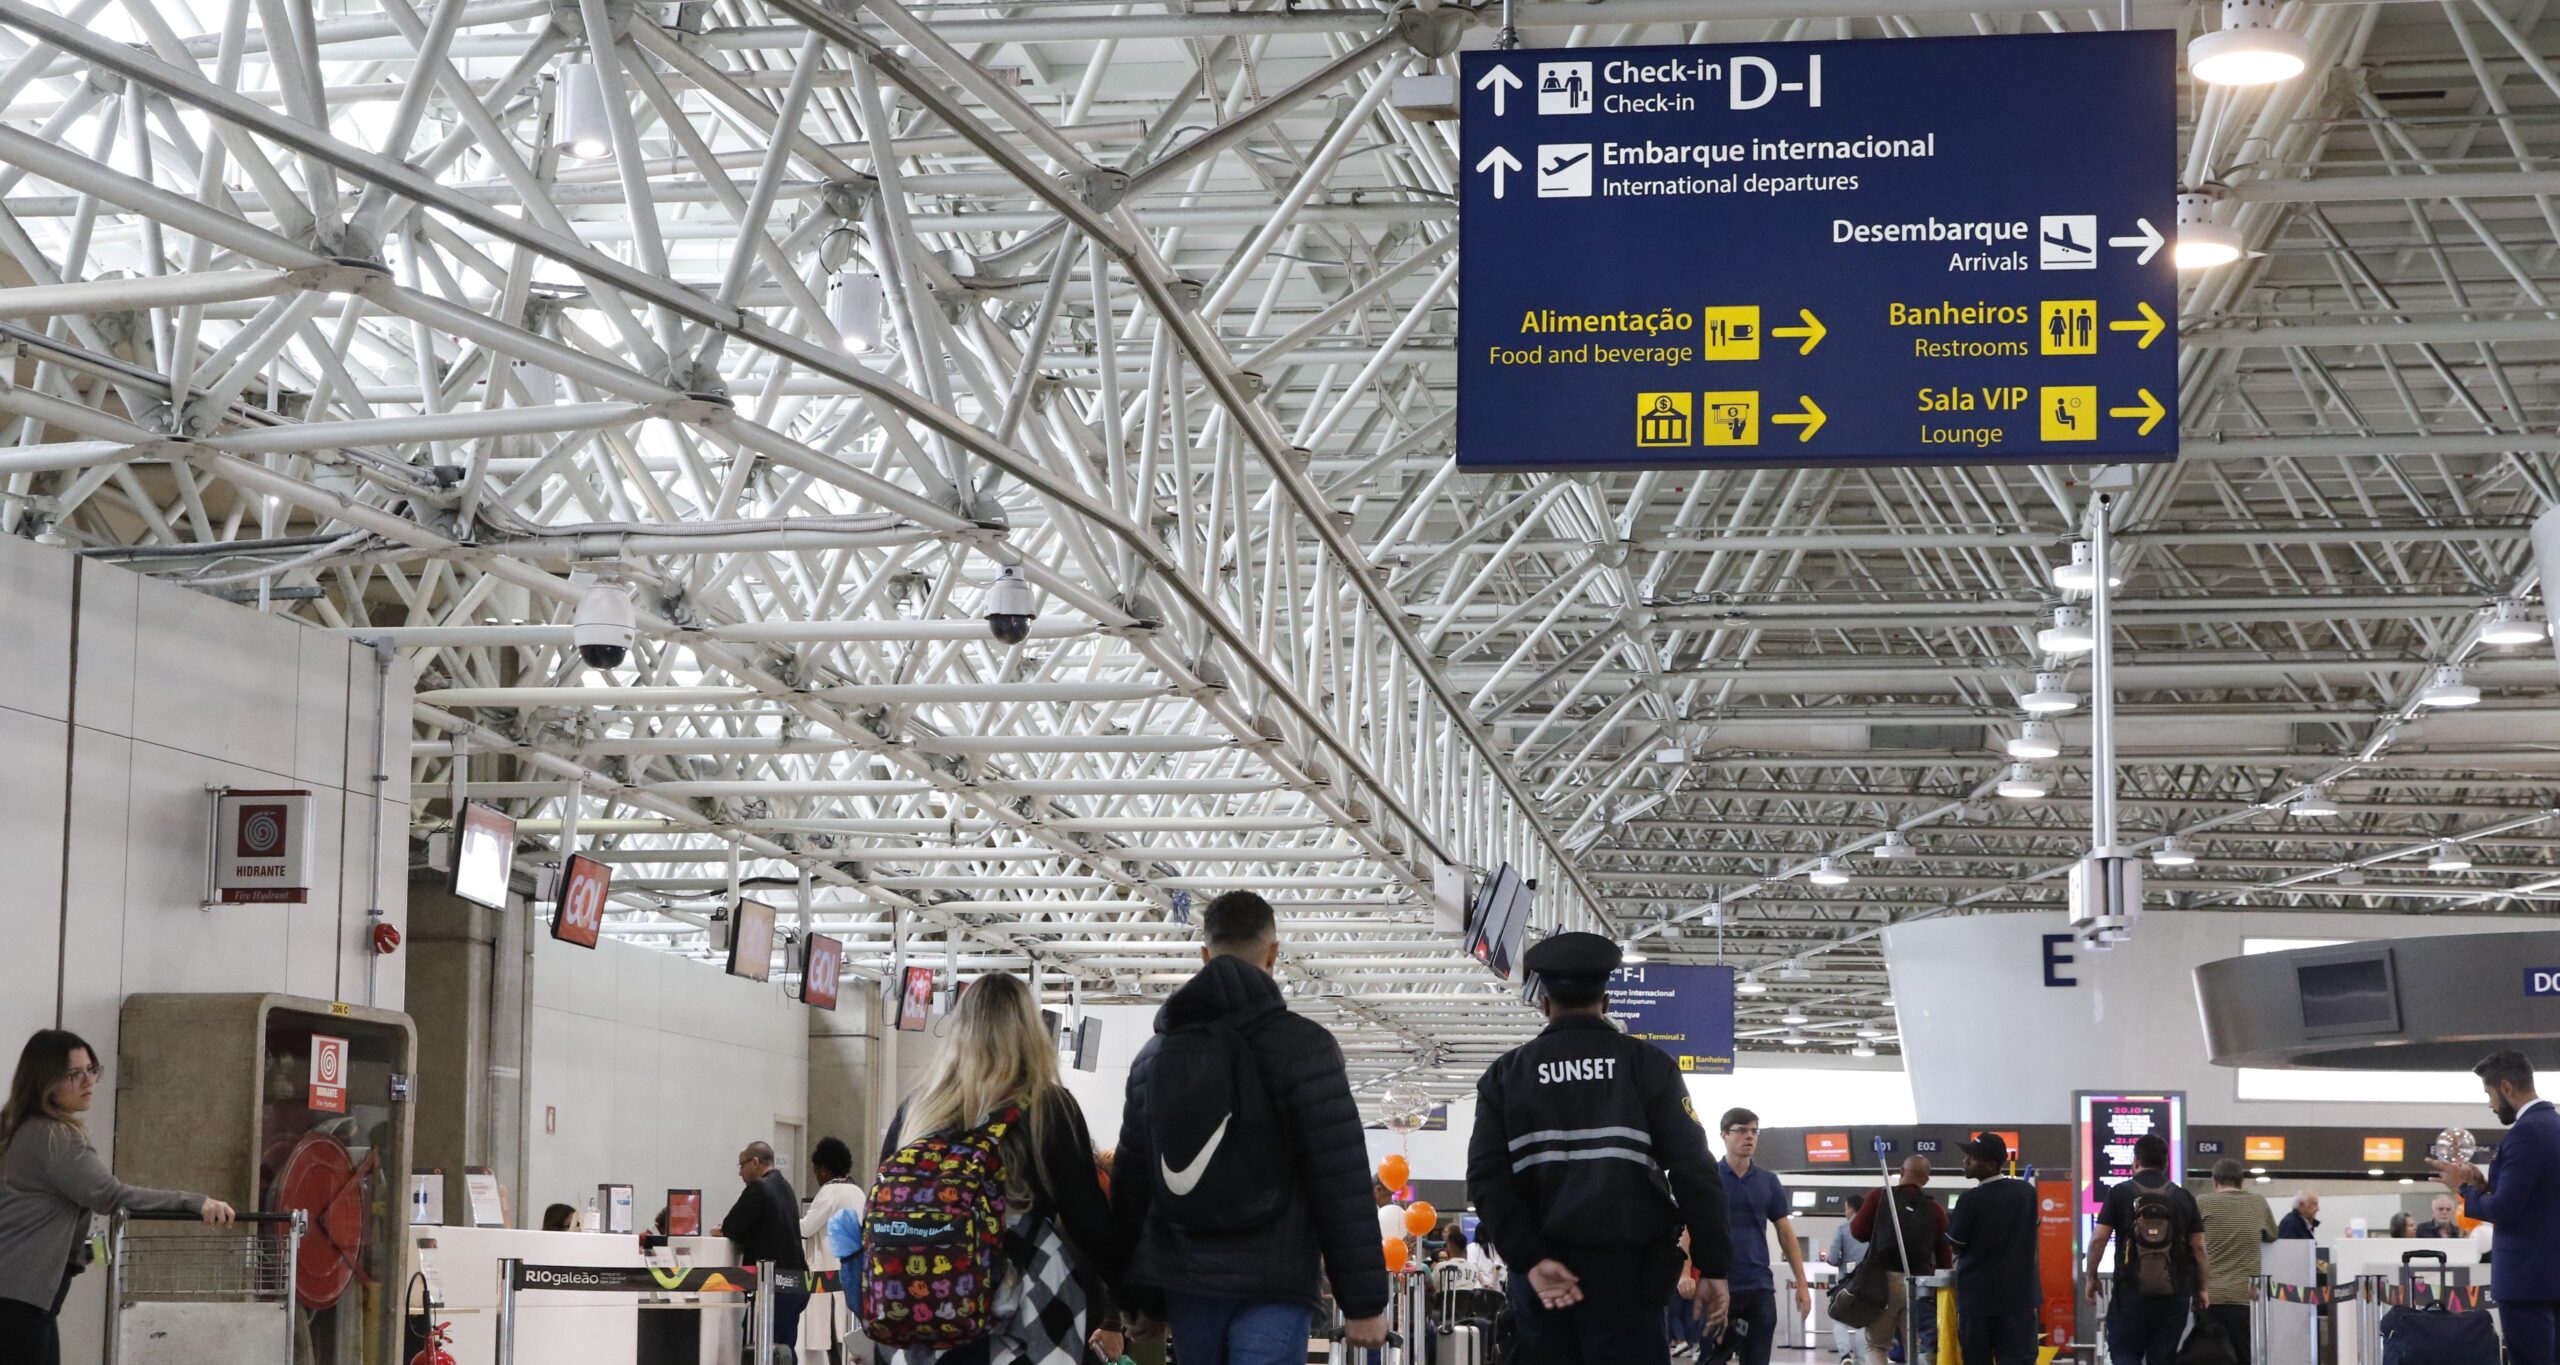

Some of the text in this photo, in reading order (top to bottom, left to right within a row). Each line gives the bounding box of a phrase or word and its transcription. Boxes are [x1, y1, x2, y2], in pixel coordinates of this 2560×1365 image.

[1603, 59, 1722, 85] Check-in
[1730, 54, 1822, 111] D-I
[1603, 94, 1695, 114] Check-in
[1603, 132, 1935, 168] Embarque internacional
[1603, 173, 1859, 196] International departures
[1833, 217, 2028, 246] Desembarque
[1948, 251, 2028, 272] Arrivals
[1521, 308, 1693, 337] Alimentação
[1889, 301, 2028, 326] Banheiros
[1489, 343, 1693, 367] Food and beverage
[1915, 338, 2028, 357] Restrooms
[1918, 387, 2028, 412] Sala VIP
[1921, 424, 2003, 447] Lounge
[236, 865, 286, 877] HIDRANTE
[234, 891, 290, 900] Fire Hydrant
[566, 874, 602, 931] GOL
[810, 948, 837, 995] GOL
[2042, 934, 2077, 987] E
[1623, 967, 1645, 983] F-I
[1628, 989, 1675, 998] internacional
[1647, 1033, 1679, 1041] Terminal
[1680, 1033, 1686, 1041] 2
[1538, 1058, 1616, 1085] SUNSET
[1696, 1056, 1731, 1064] Banheiros
[1917, 1141, 1936, 1151] E02
[2199, 1142, 2217, 1152] E04
[873, 1223, 891, 1233] Walt
[525, 1270, 599, 1286] RIOgaleão
